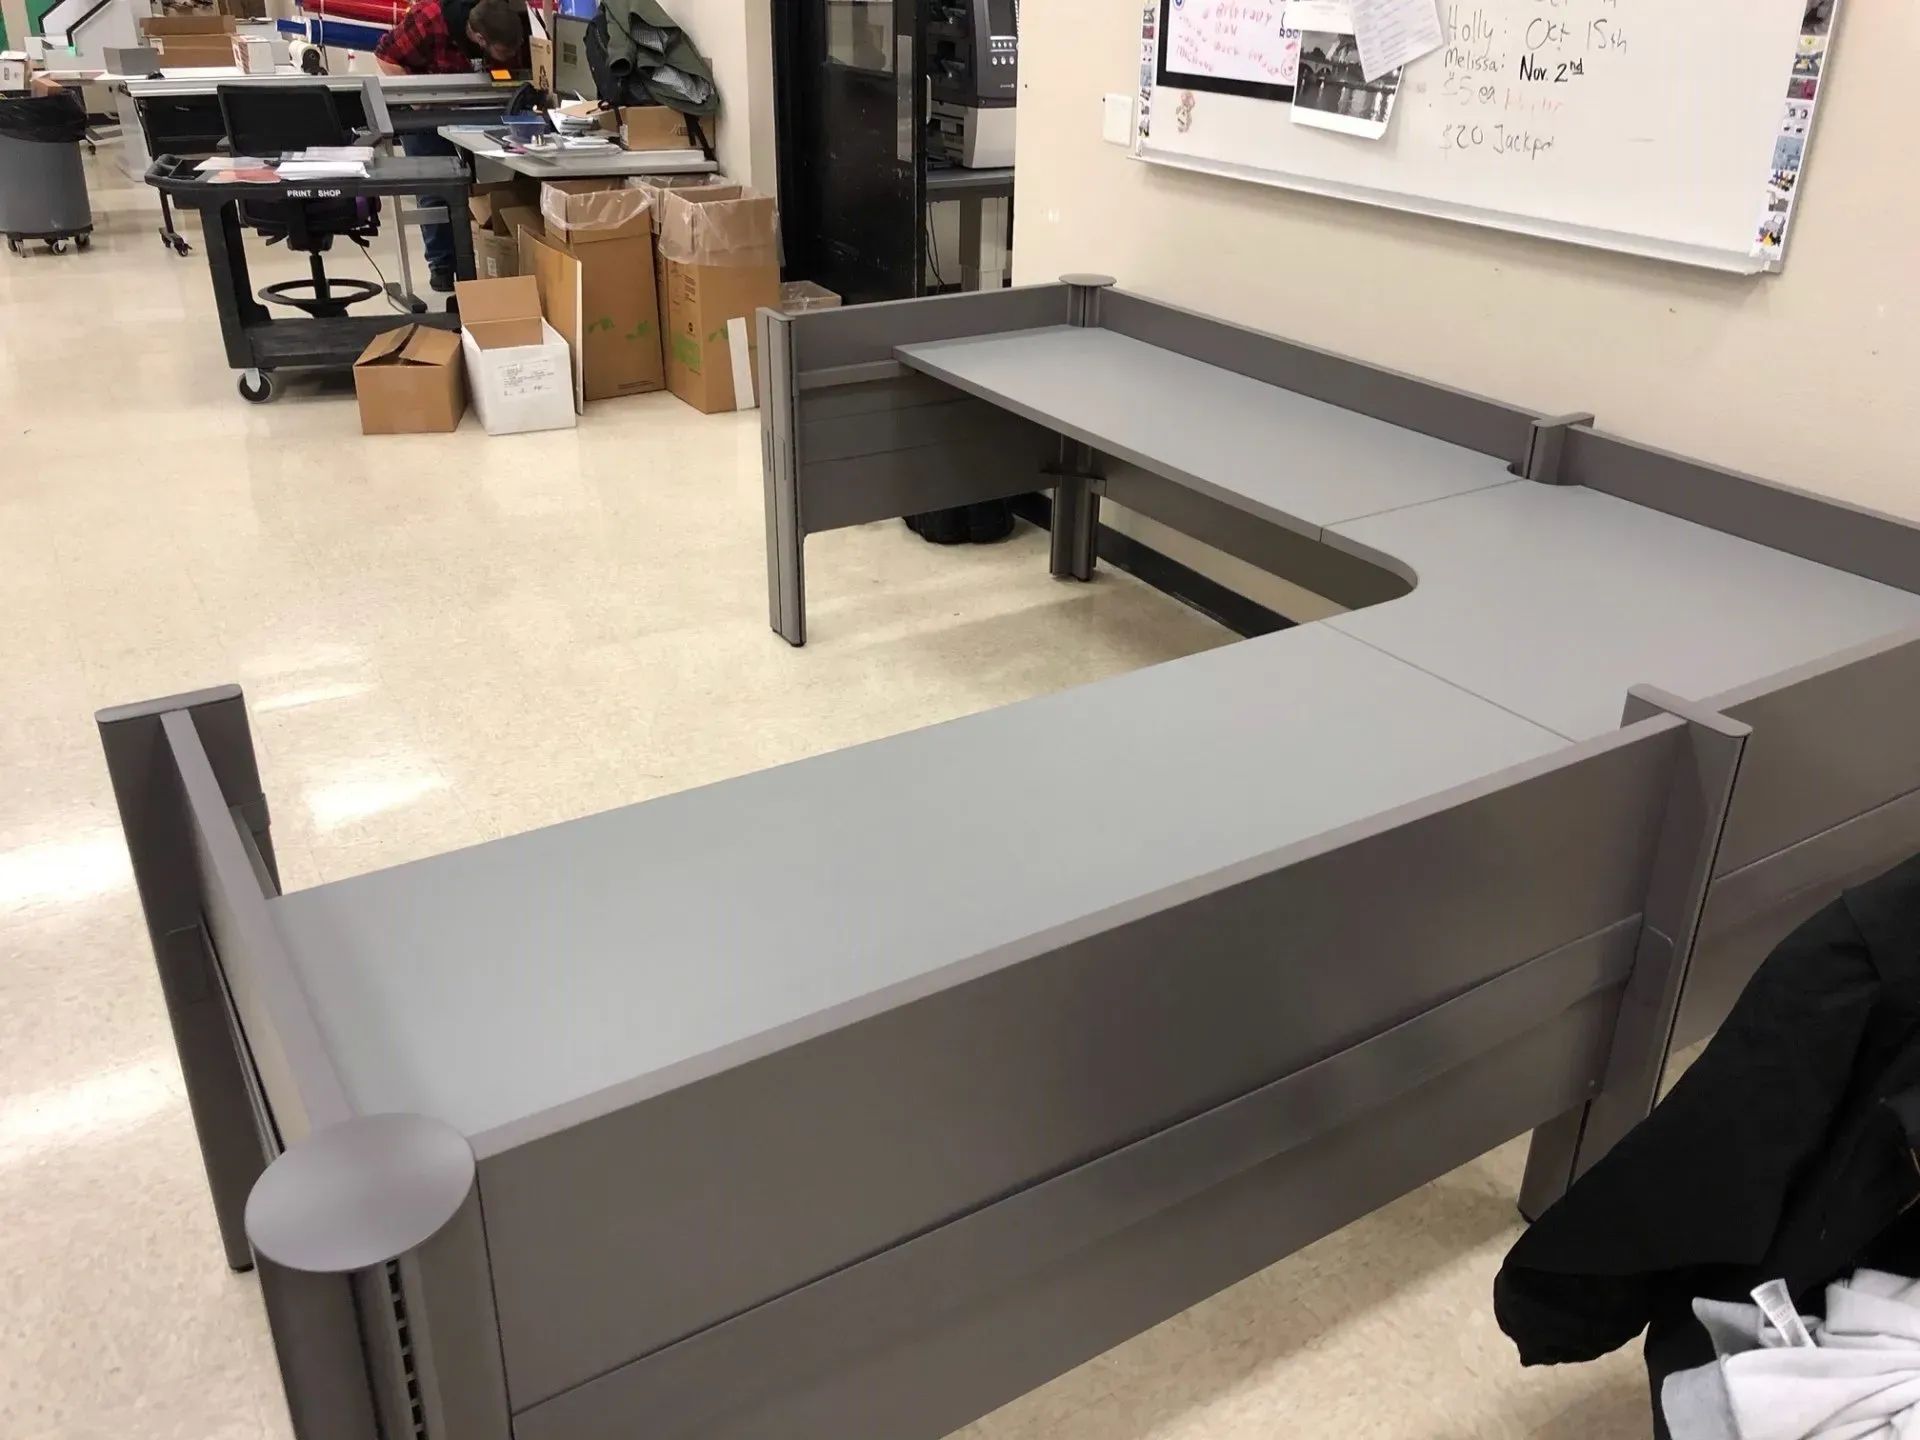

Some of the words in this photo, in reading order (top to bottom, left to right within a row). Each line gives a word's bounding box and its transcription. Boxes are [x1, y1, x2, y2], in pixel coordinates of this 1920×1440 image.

[1526, 17, 1570, 50] Oct
[1519, 53, 1549, 82] Nov.
[1554, 57, 1584, 83] 2nd
[286, 189, 312, 197] PRINT
[317, 189, 341, 197] SHOP
